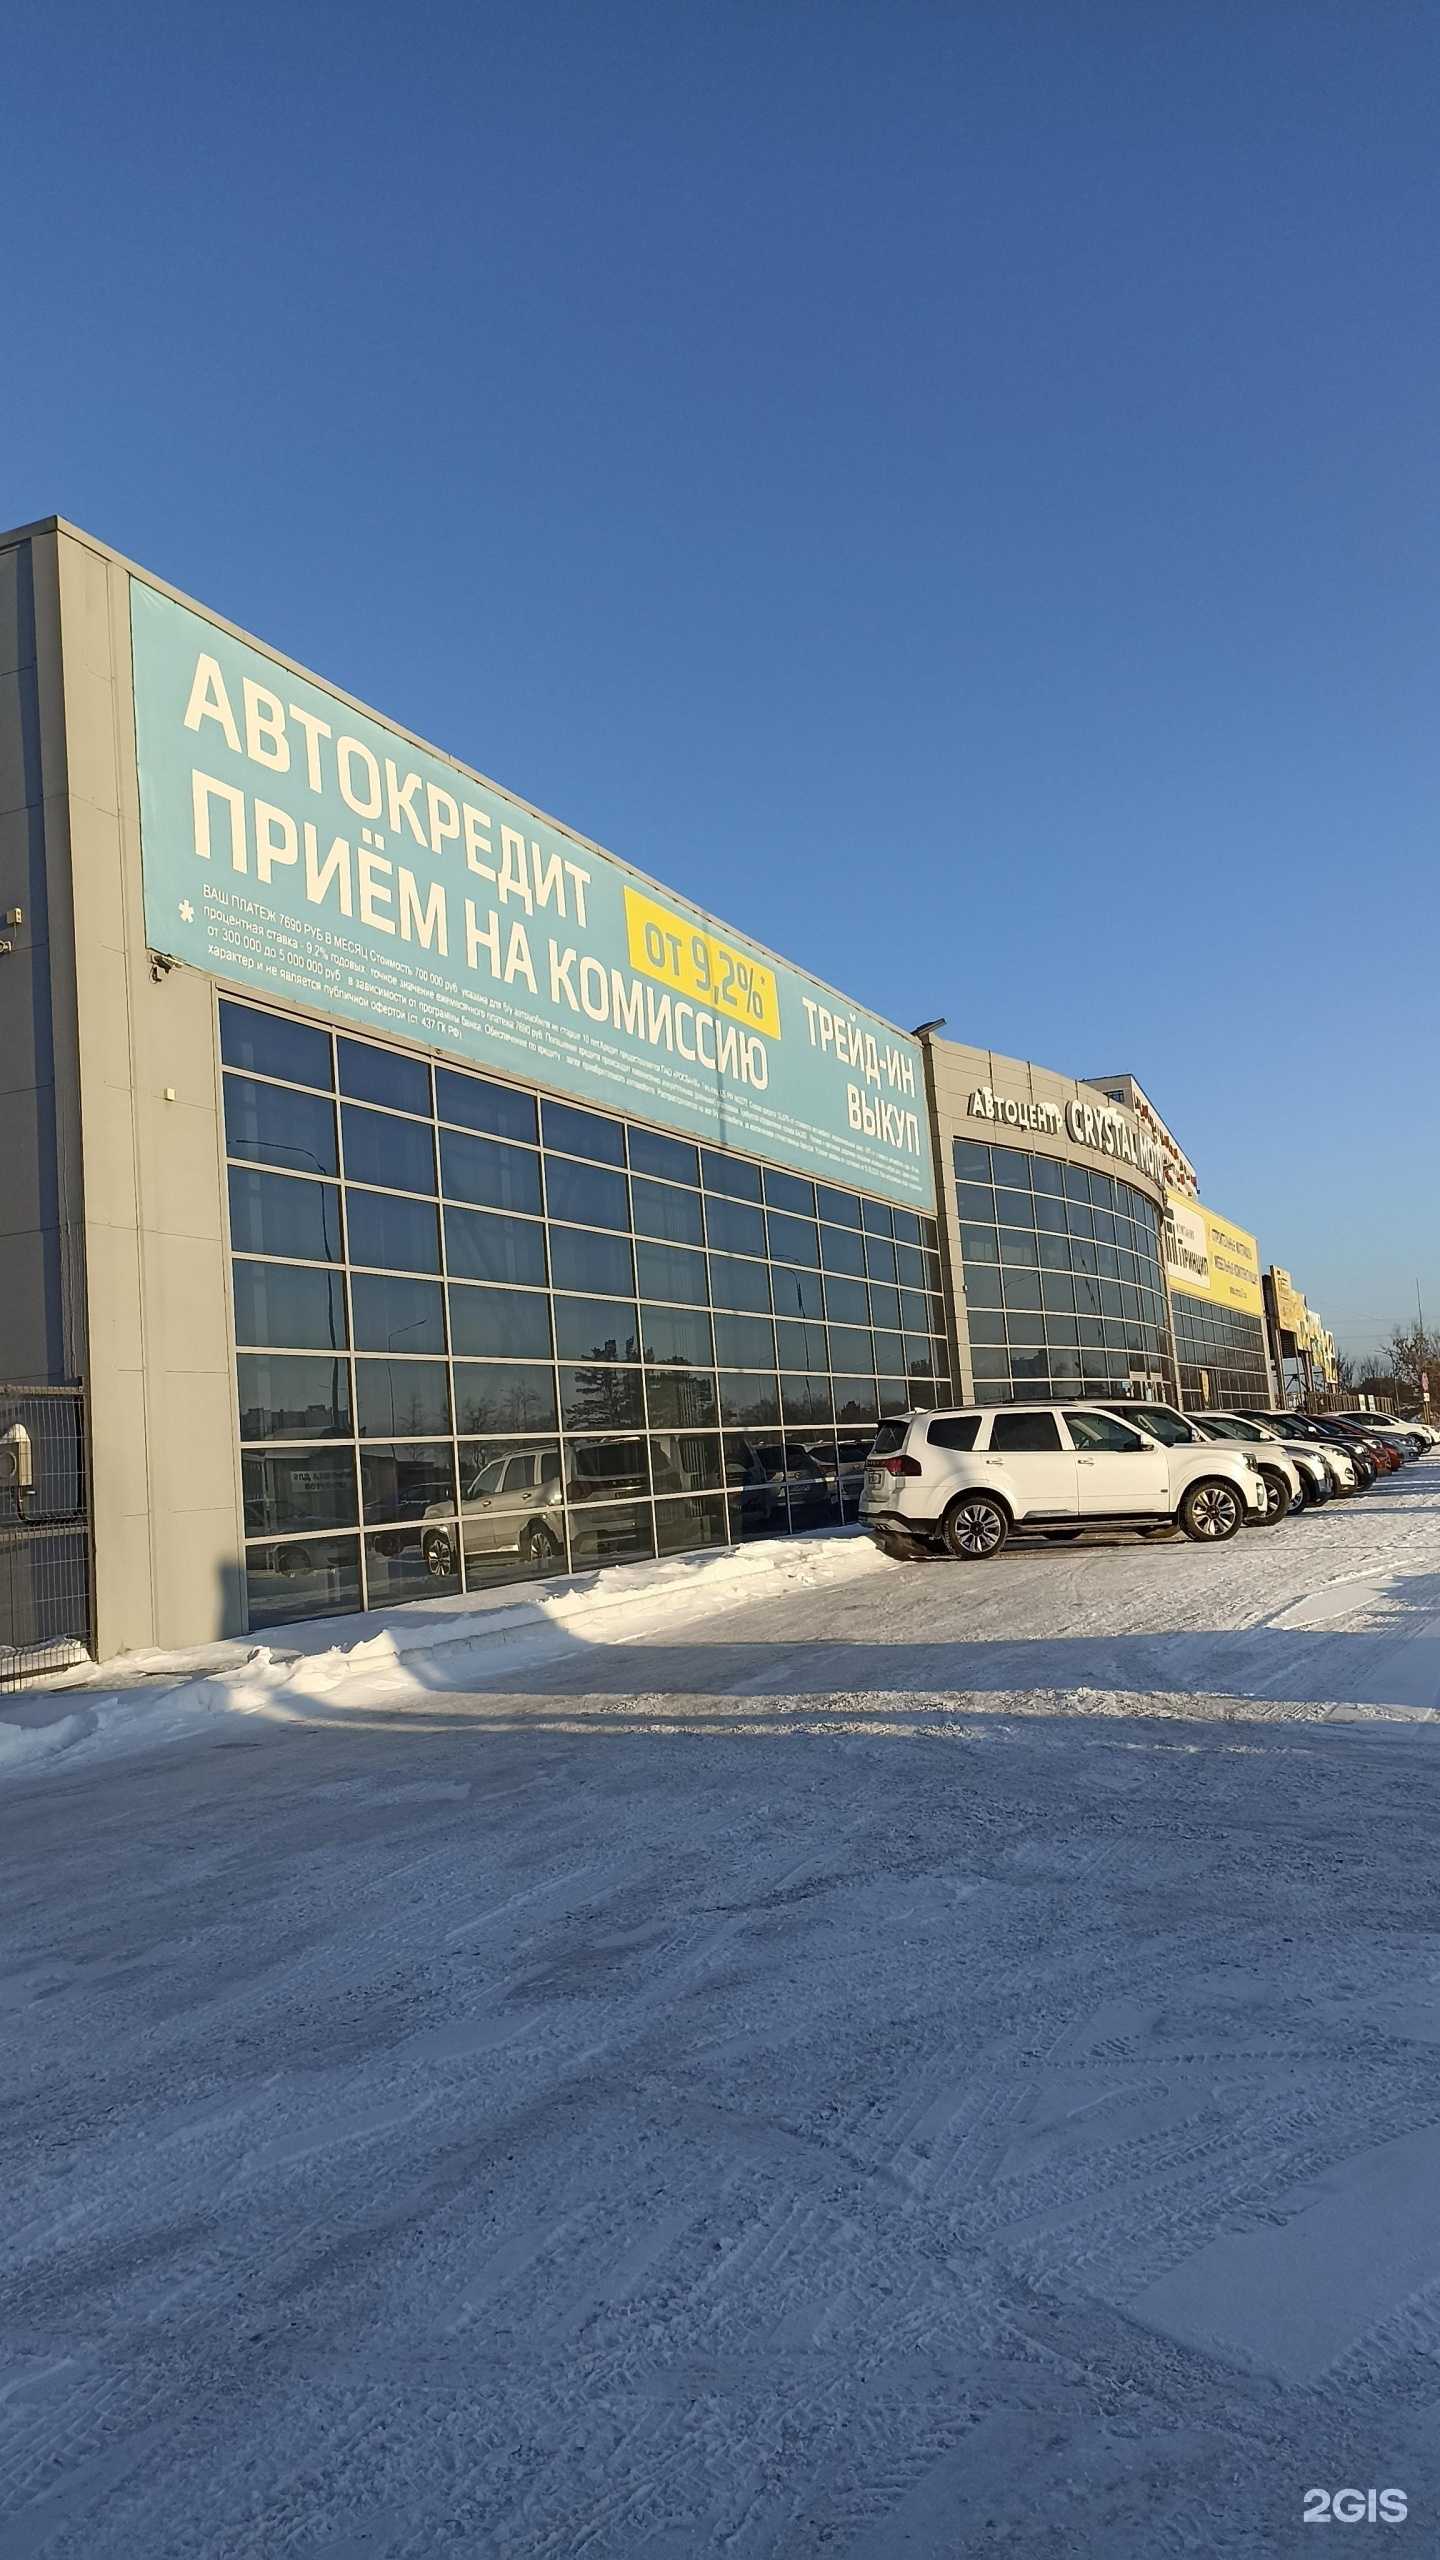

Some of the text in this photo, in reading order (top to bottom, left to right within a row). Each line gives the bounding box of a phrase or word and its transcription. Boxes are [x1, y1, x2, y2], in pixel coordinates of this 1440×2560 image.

[183, 652, 591, 928] АВТОКРЕДИТ
[191, 768, 770, 1091] ПРИЁМ НА КОМИССИЮ
[203, 884, 229, 904] ВАШ
[231, 895, 276, 923] ПЛАТЕЖ
[279, 913, 301, 932] 7690
[304, 923, 323, 941] РУБ
[325, 932, 331, 943] В
[334, 935, 368, 959] МЕСЯЦ
[369, 949, 412, 975] Стоимость
[415, 967, 428, 980] 700
[431, 974, 443, 986] 000
[203, 904, 264, 938] процентная
[266, 929, 298, 948] ставка
[370, 968, 398, 985] точное
[399, 980, 434, 999] значение
[207, 926, 218, 936] от
[222, 928, 241, 945] 300
[243, 936, 262, 953] 000
[263, 947, 277, 958] до
[279, 949, 285, 960] 5
[287, 952, 305, 968] 000
[306, 959, 323, 975] 000
[355, 979, 407, 1004] зависимости
[408, 998, 417, 1007] от
[208, 943, 254, 970] характер
[266, 965, 278, 975] не
[279, 969, 321, 990] является
[421, 1015, 435, 1029] 437
[801, 996, 916, 1098] ТРЕЙД-ИН
[847, 1083, 921, 1157] ВЫКУП
[1067, 1099, 1138, 1165] CRYSTAL
